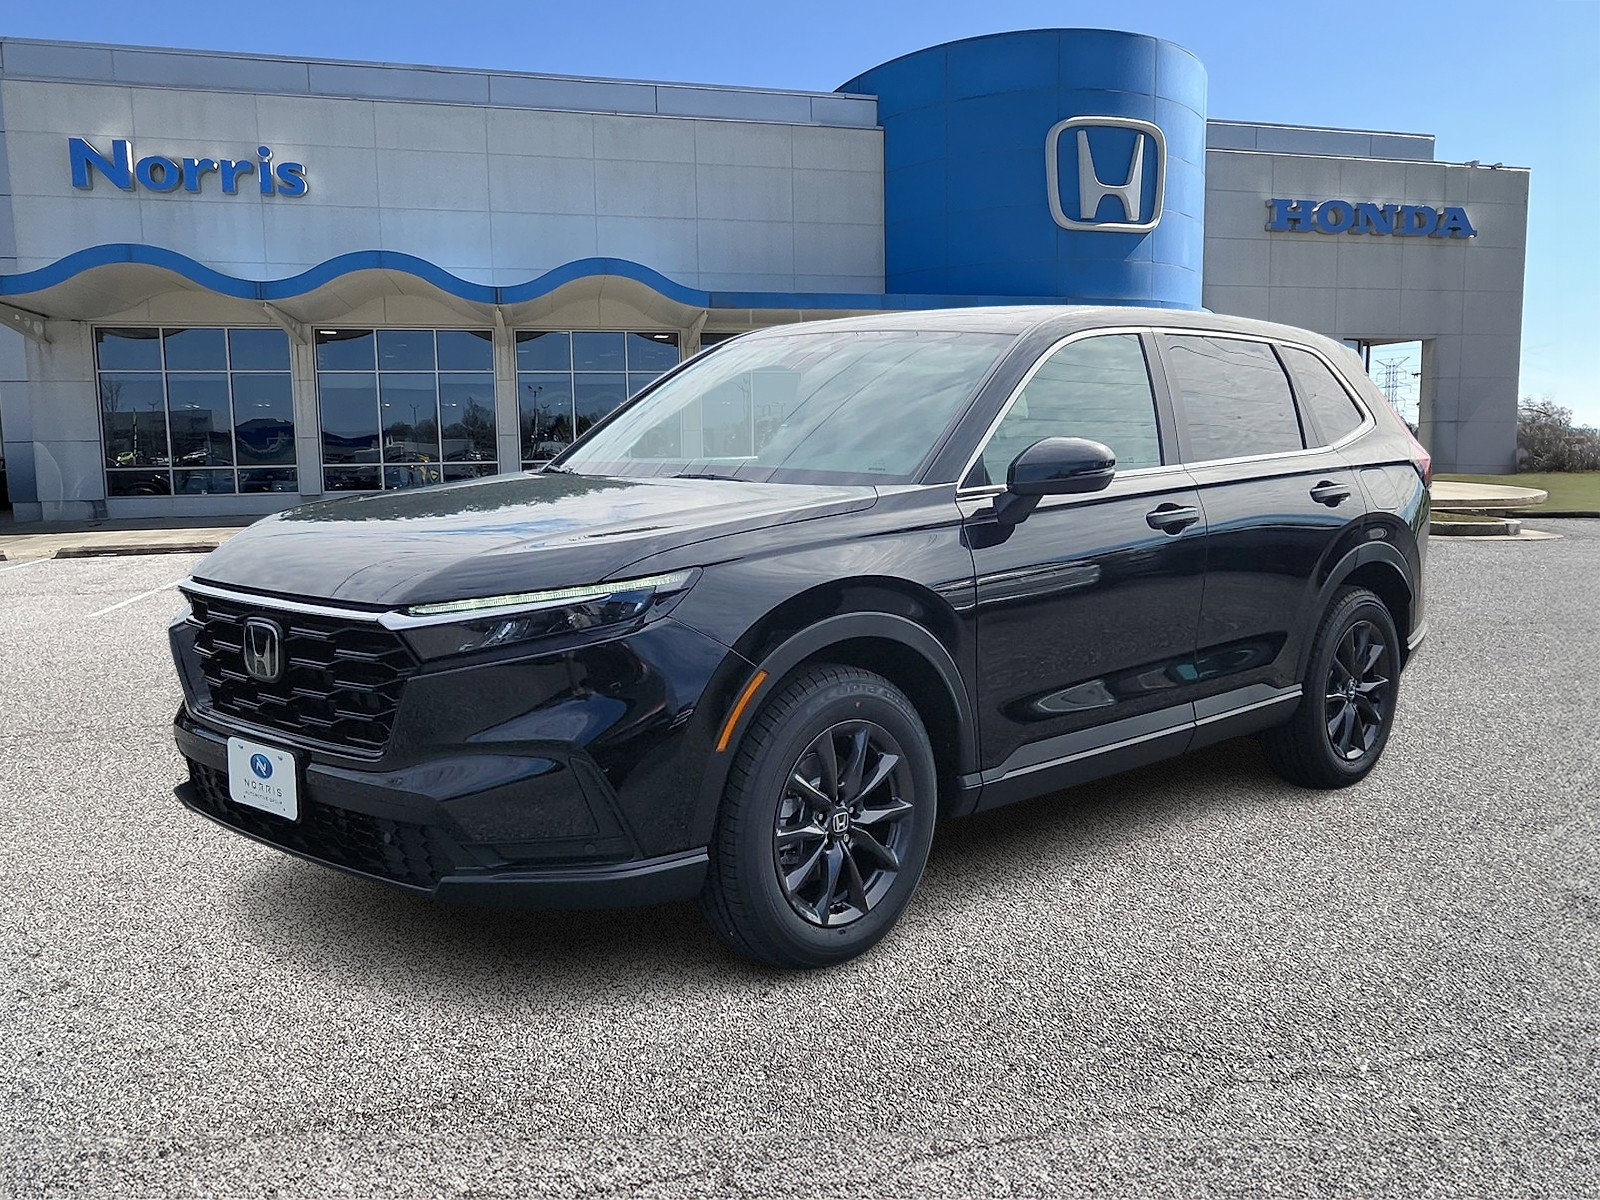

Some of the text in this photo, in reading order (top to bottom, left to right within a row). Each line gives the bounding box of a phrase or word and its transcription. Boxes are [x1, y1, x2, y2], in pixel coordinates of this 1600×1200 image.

[68, 137, 309, 197] Norris
[1265, 198, 1478, 239] HONDA
[244, 779, 282, 797] NORRIS
